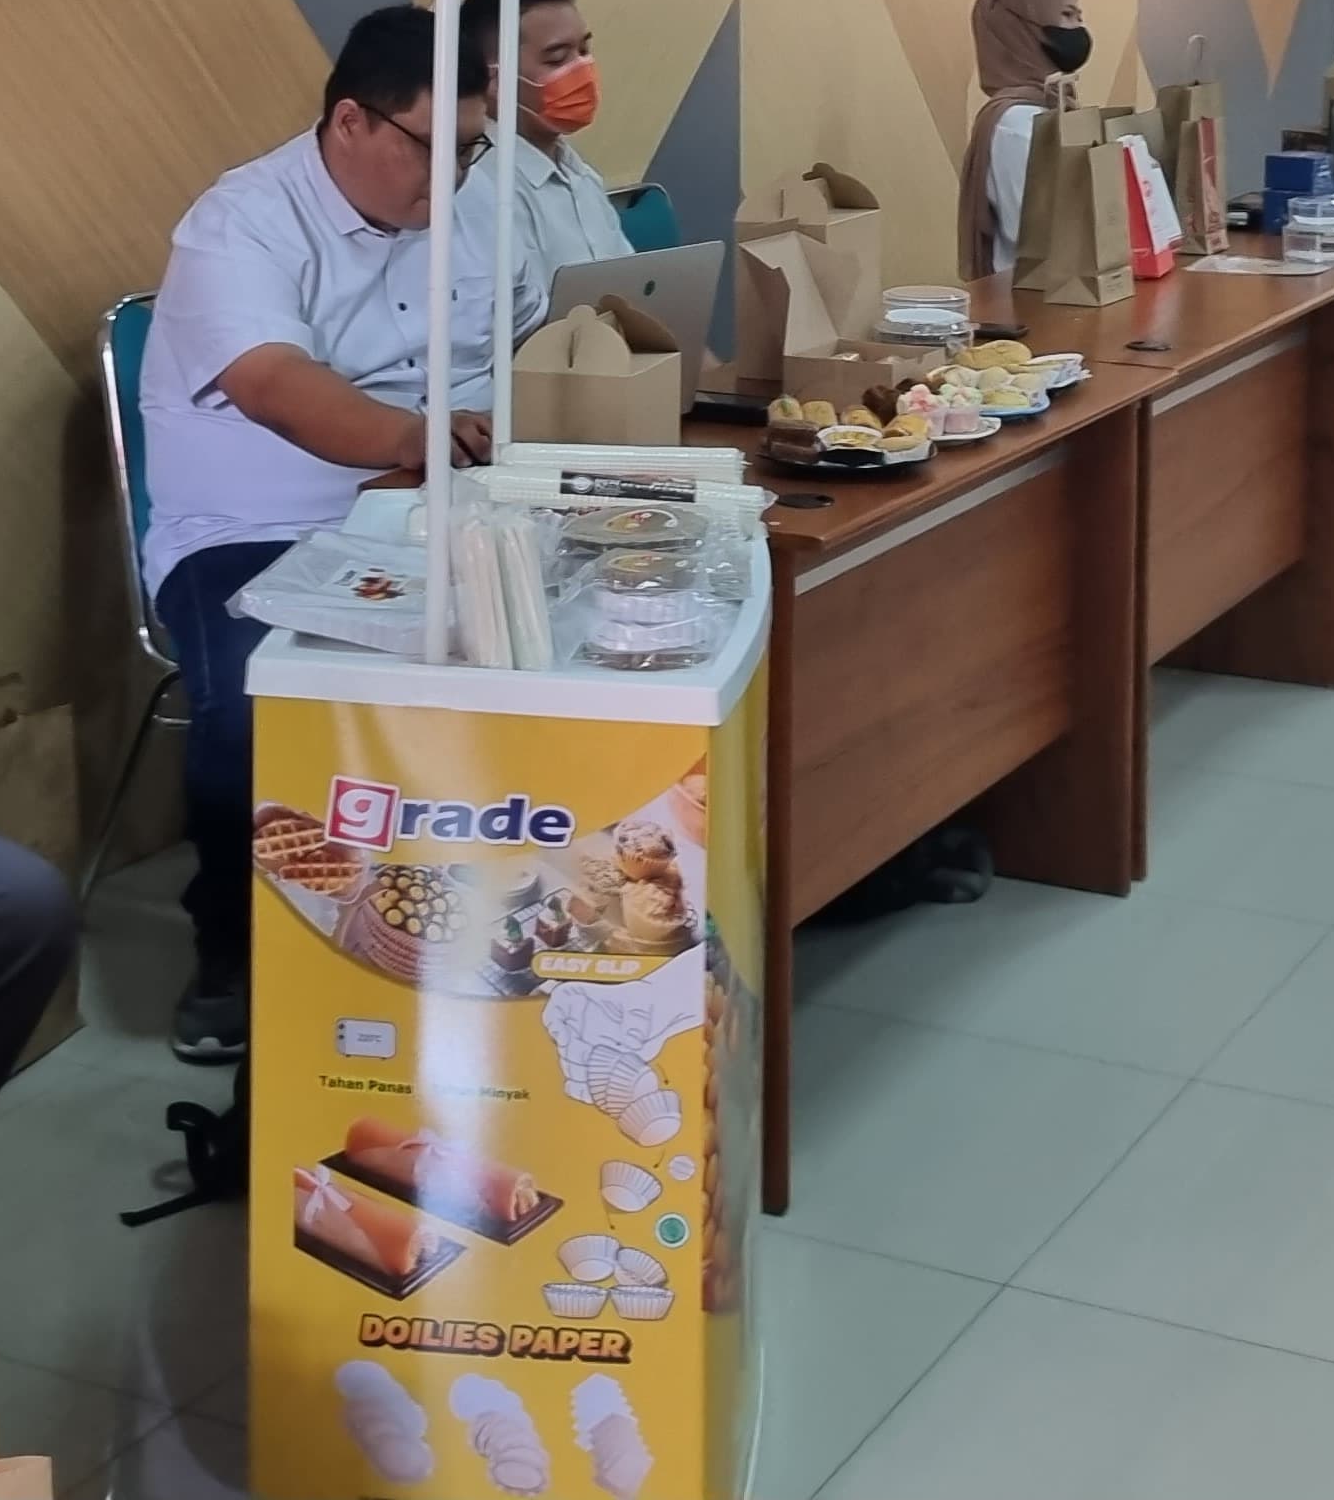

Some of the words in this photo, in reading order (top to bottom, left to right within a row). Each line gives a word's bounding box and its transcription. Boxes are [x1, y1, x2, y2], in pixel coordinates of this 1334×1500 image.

[338, 787, 572, 843] grade
[539, 955, 593, 973] EASY
[318, 1075, 365, 1091] Tahan
[367, 1079, 413, 1095] Panas
[359, 1314, 504, 1357] DOILIES
[508, 1325, 632, 1364] PAPER
